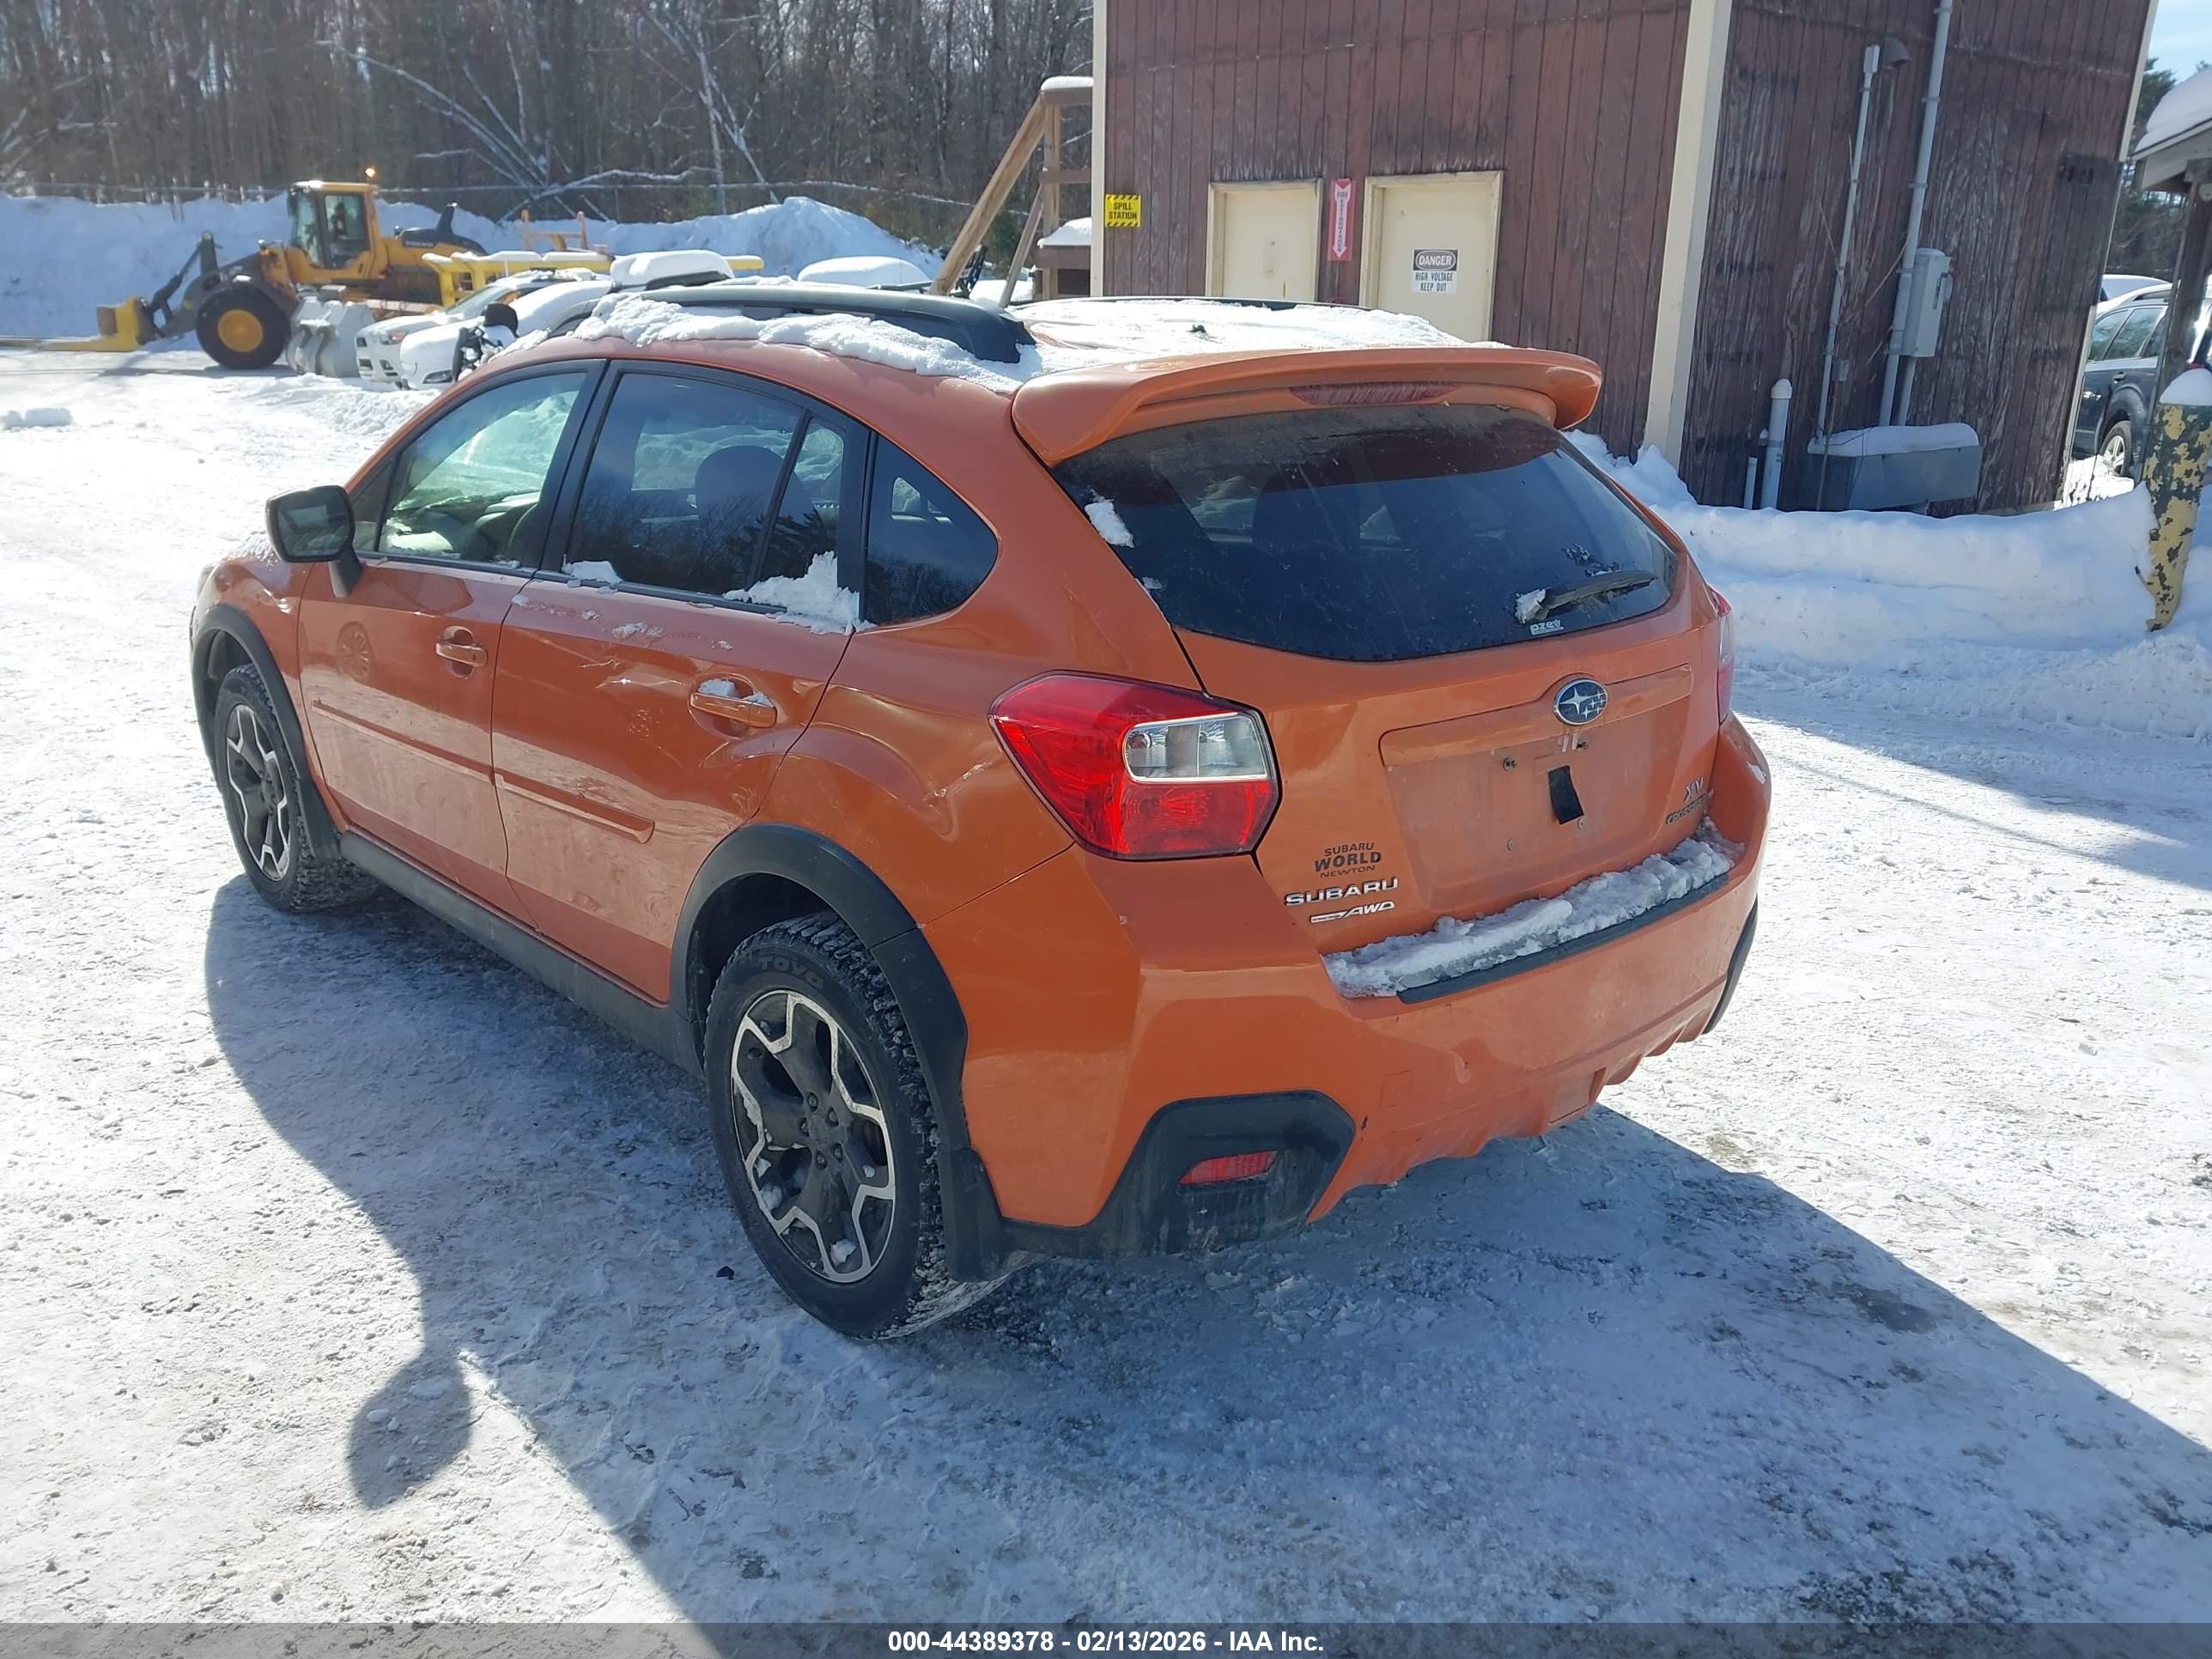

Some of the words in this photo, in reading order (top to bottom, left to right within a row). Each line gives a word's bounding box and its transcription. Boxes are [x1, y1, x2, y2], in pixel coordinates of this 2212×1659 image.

[1113, 202, 1132, 210] SPILL
[1108, 211, 1137, 220] STATION
[1419, 255, 1452, 266] DANGER
[1414, 271, 1428, 281] HIGH
[1431, 271, 1453, 282] VOLTAGE
[1419, 283, 1434, 292] KEEP
[1436, 283, 1447, 292] OUT
[1324, 842, 1375, 857] SUBARU
[1314, 851, 1382, 872] WORLD
[1320, 865, 1375, 878] NEWTON
[1285, 877, 1399, 906] SUBARU
[1345, 901, 1395, 917] AWD
[757, 957, 823, 989] TOYO
